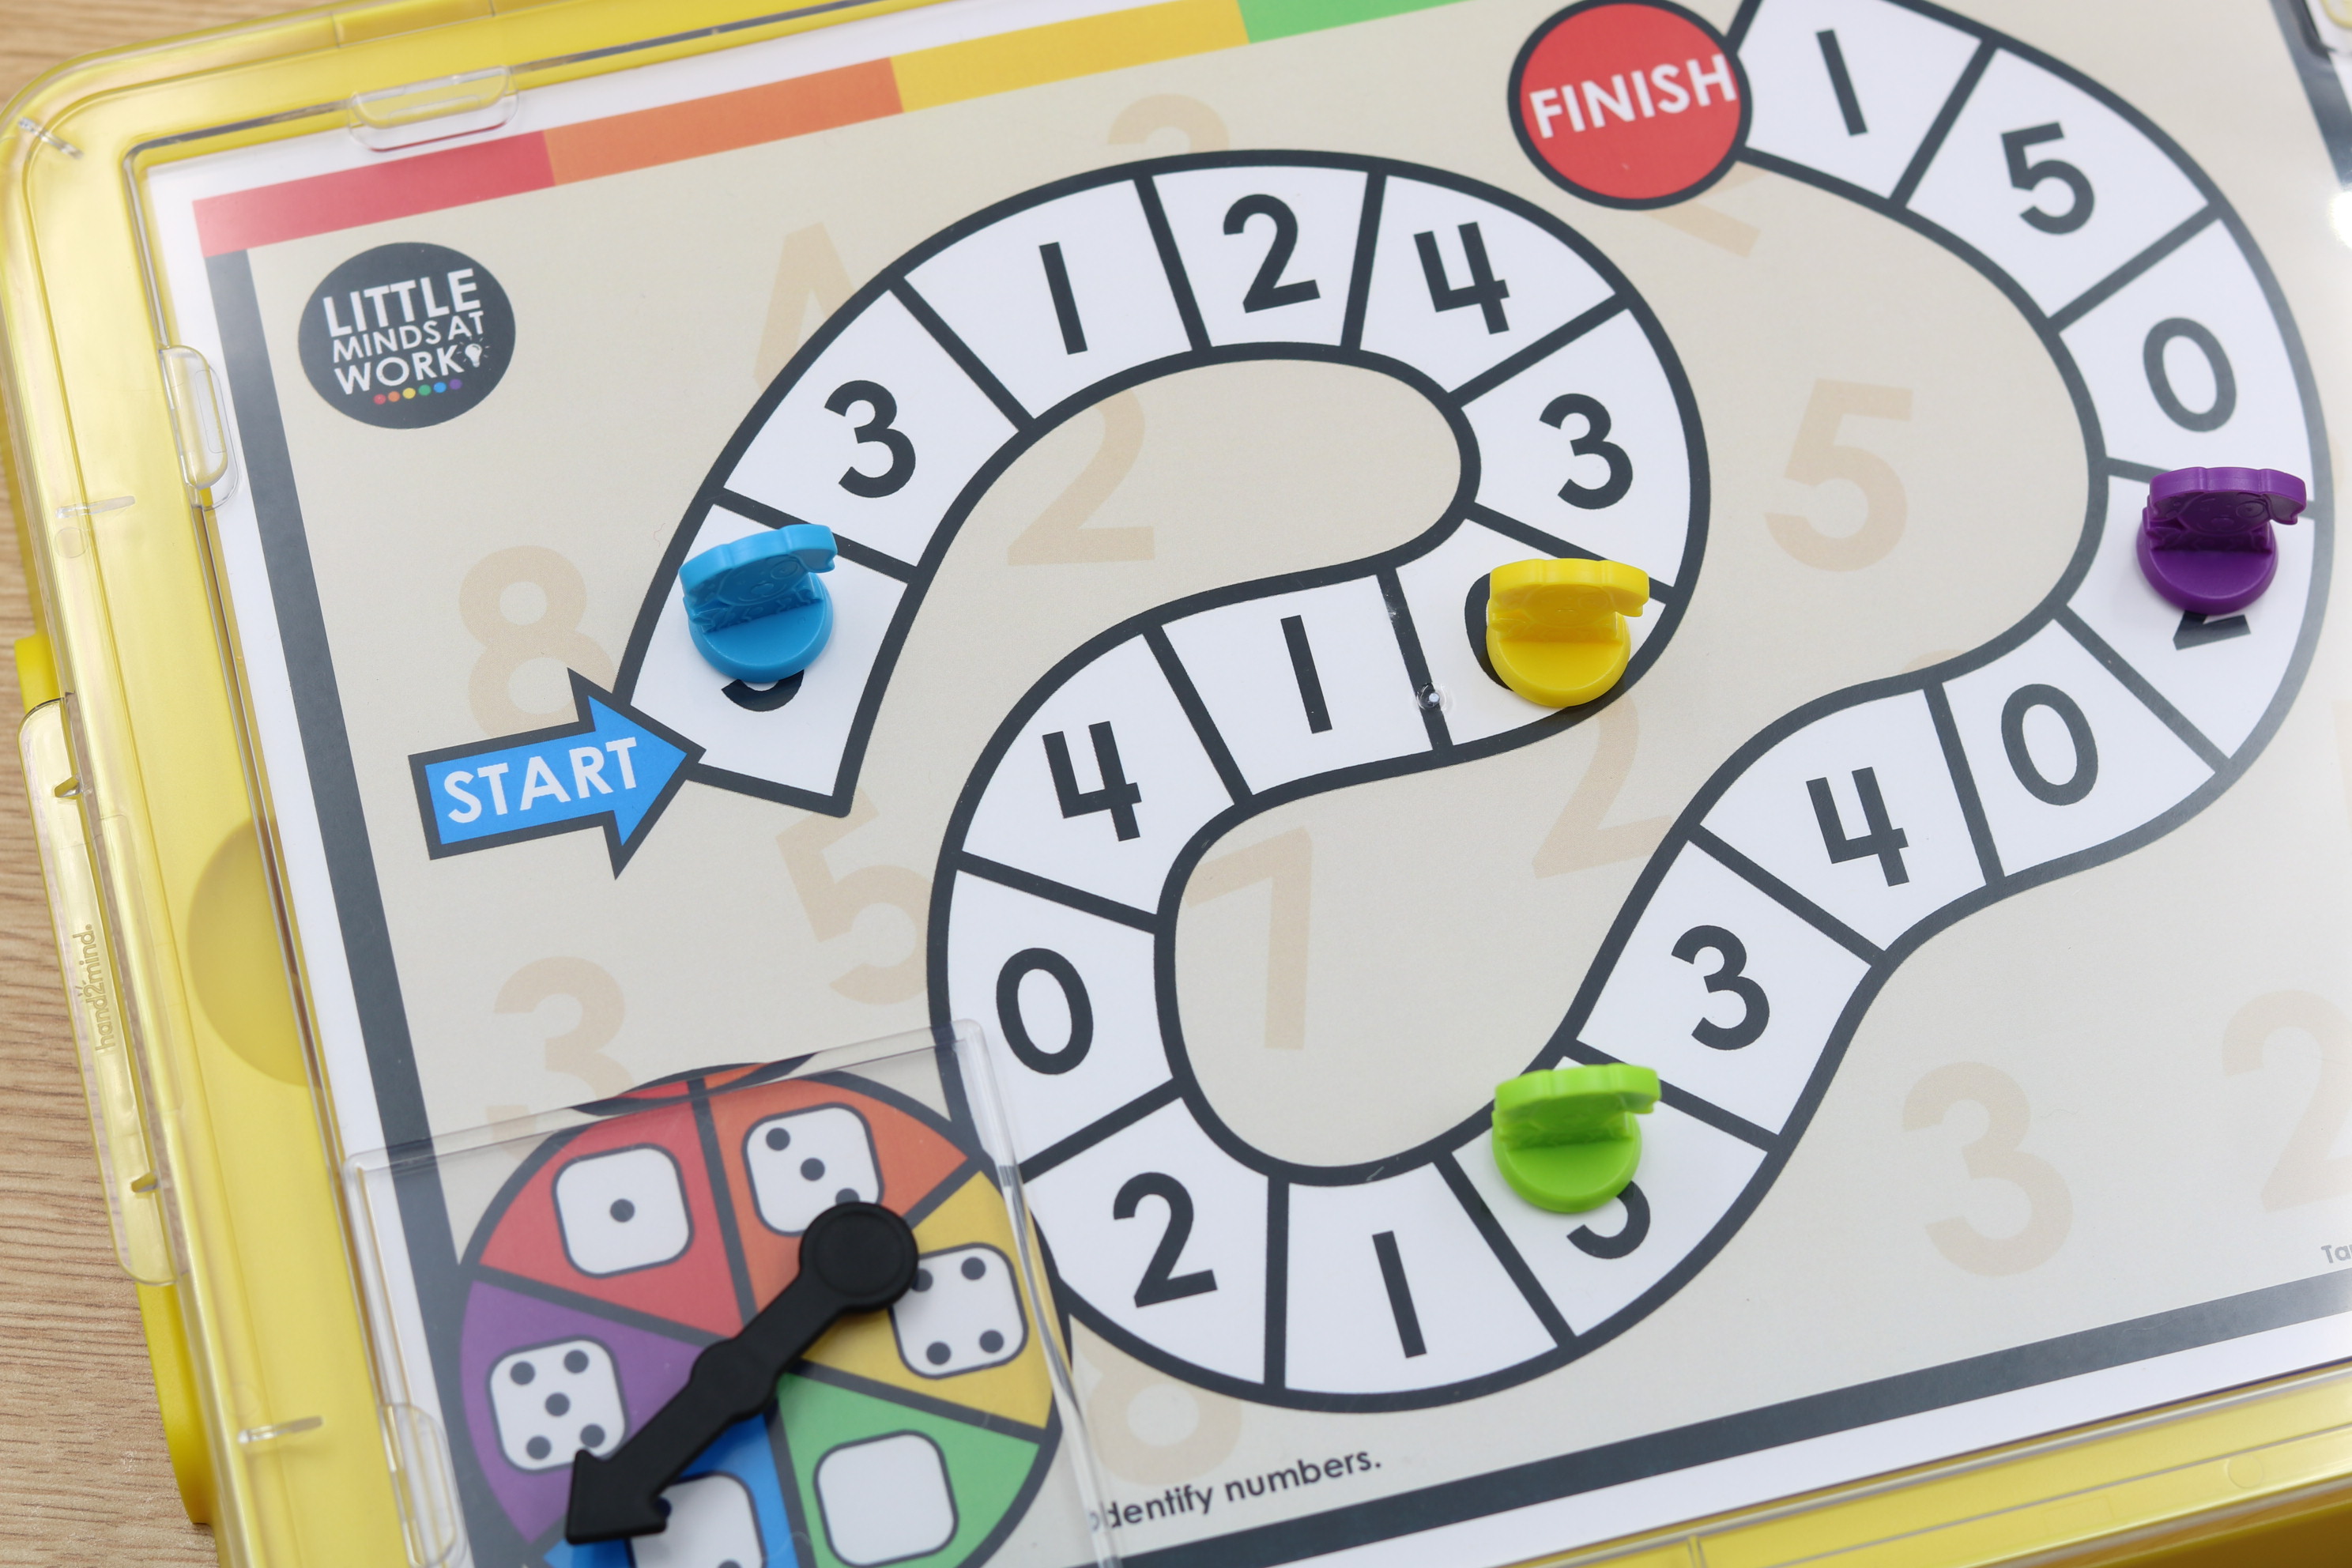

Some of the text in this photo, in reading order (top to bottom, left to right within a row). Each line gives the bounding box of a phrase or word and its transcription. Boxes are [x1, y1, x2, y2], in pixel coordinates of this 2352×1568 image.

[1529, 53, 1737, 138] FINISH
[2001, 122, 2094, 235] 5
[323, 268, 481, 337] LITTLE
[1223, 194, 1321, 314] 2
[1413, 221, 1510, 335] 4
[334, 311, 484, 364] MINDS AT
[334, 345, 465, 395] WORK
[2143, 317, 2237, 432] 0
[824, 379, 917, 499] 3
[1539, 393, 1634, 511] 3
[1765, 378, 1913, 572] 5
[443, 736, 638, 824] START
[1042, 720, 1142, 842] 4
[2000, 684, 2098, 806] 0
[1805, 766, 1910, 888] 4
[995, 947, 1094, 1076] 0
[1671, 925, 1770, 1051] 3
[1901, 1061, 2074, 1277] 3
[1113, 1171, 1218, 1309] 2
[1104, 1450, 1381, 1528] dentify numbers.
